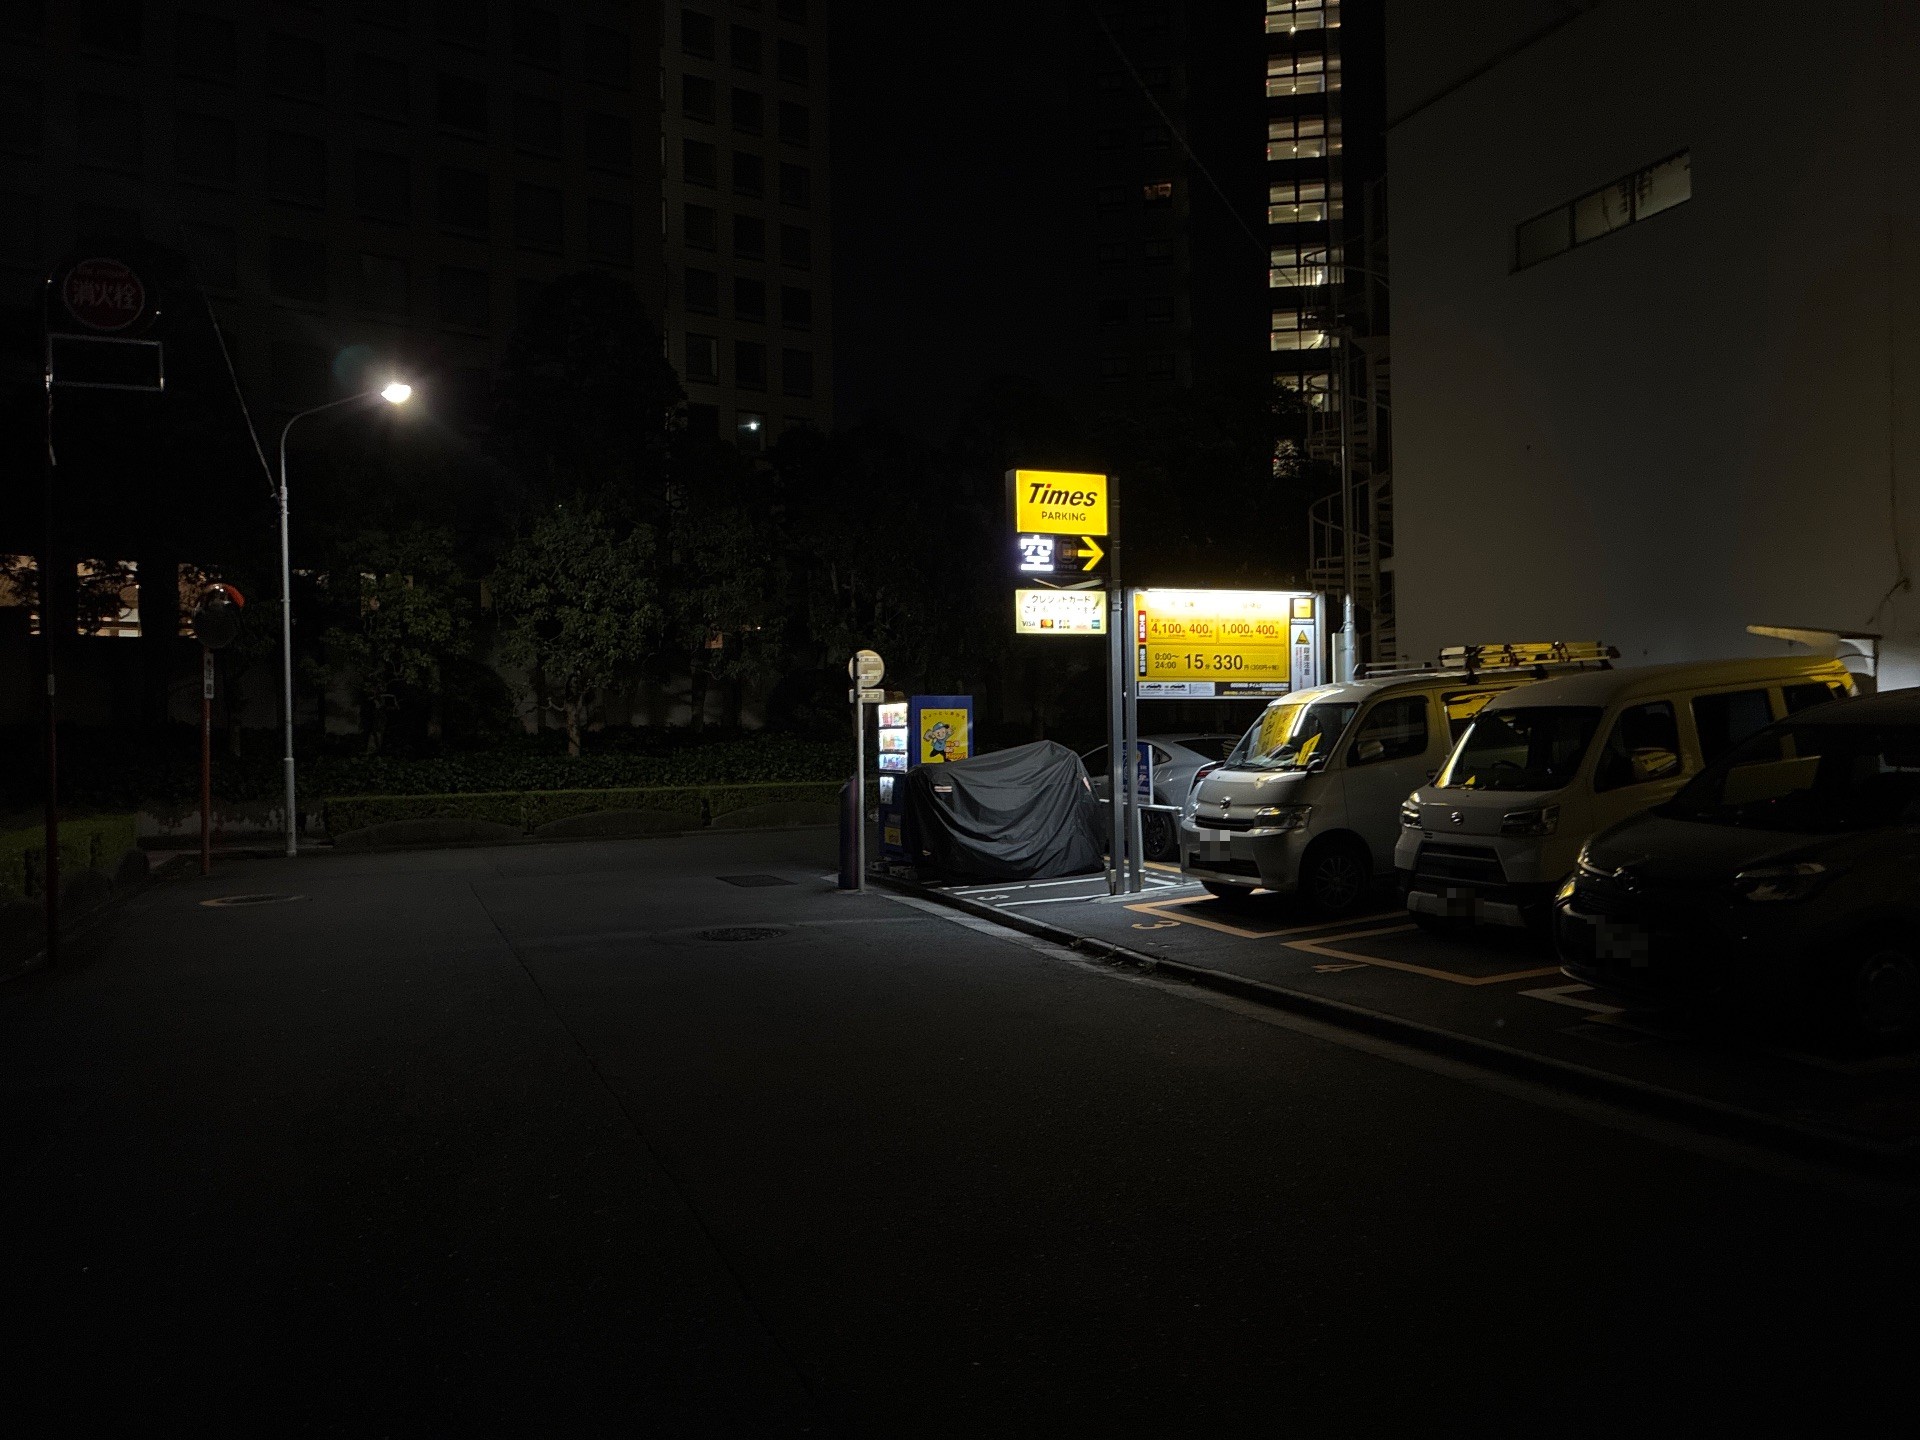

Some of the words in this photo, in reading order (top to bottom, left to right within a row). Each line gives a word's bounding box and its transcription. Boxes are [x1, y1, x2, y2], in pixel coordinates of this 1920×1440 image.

[1029, 483, 1098, 507] Times
[1042, 511, 1086, 522] PARKING
[1020, 535, 1054, 571] 空
[1154, 661, 1177, 669] 24:00
